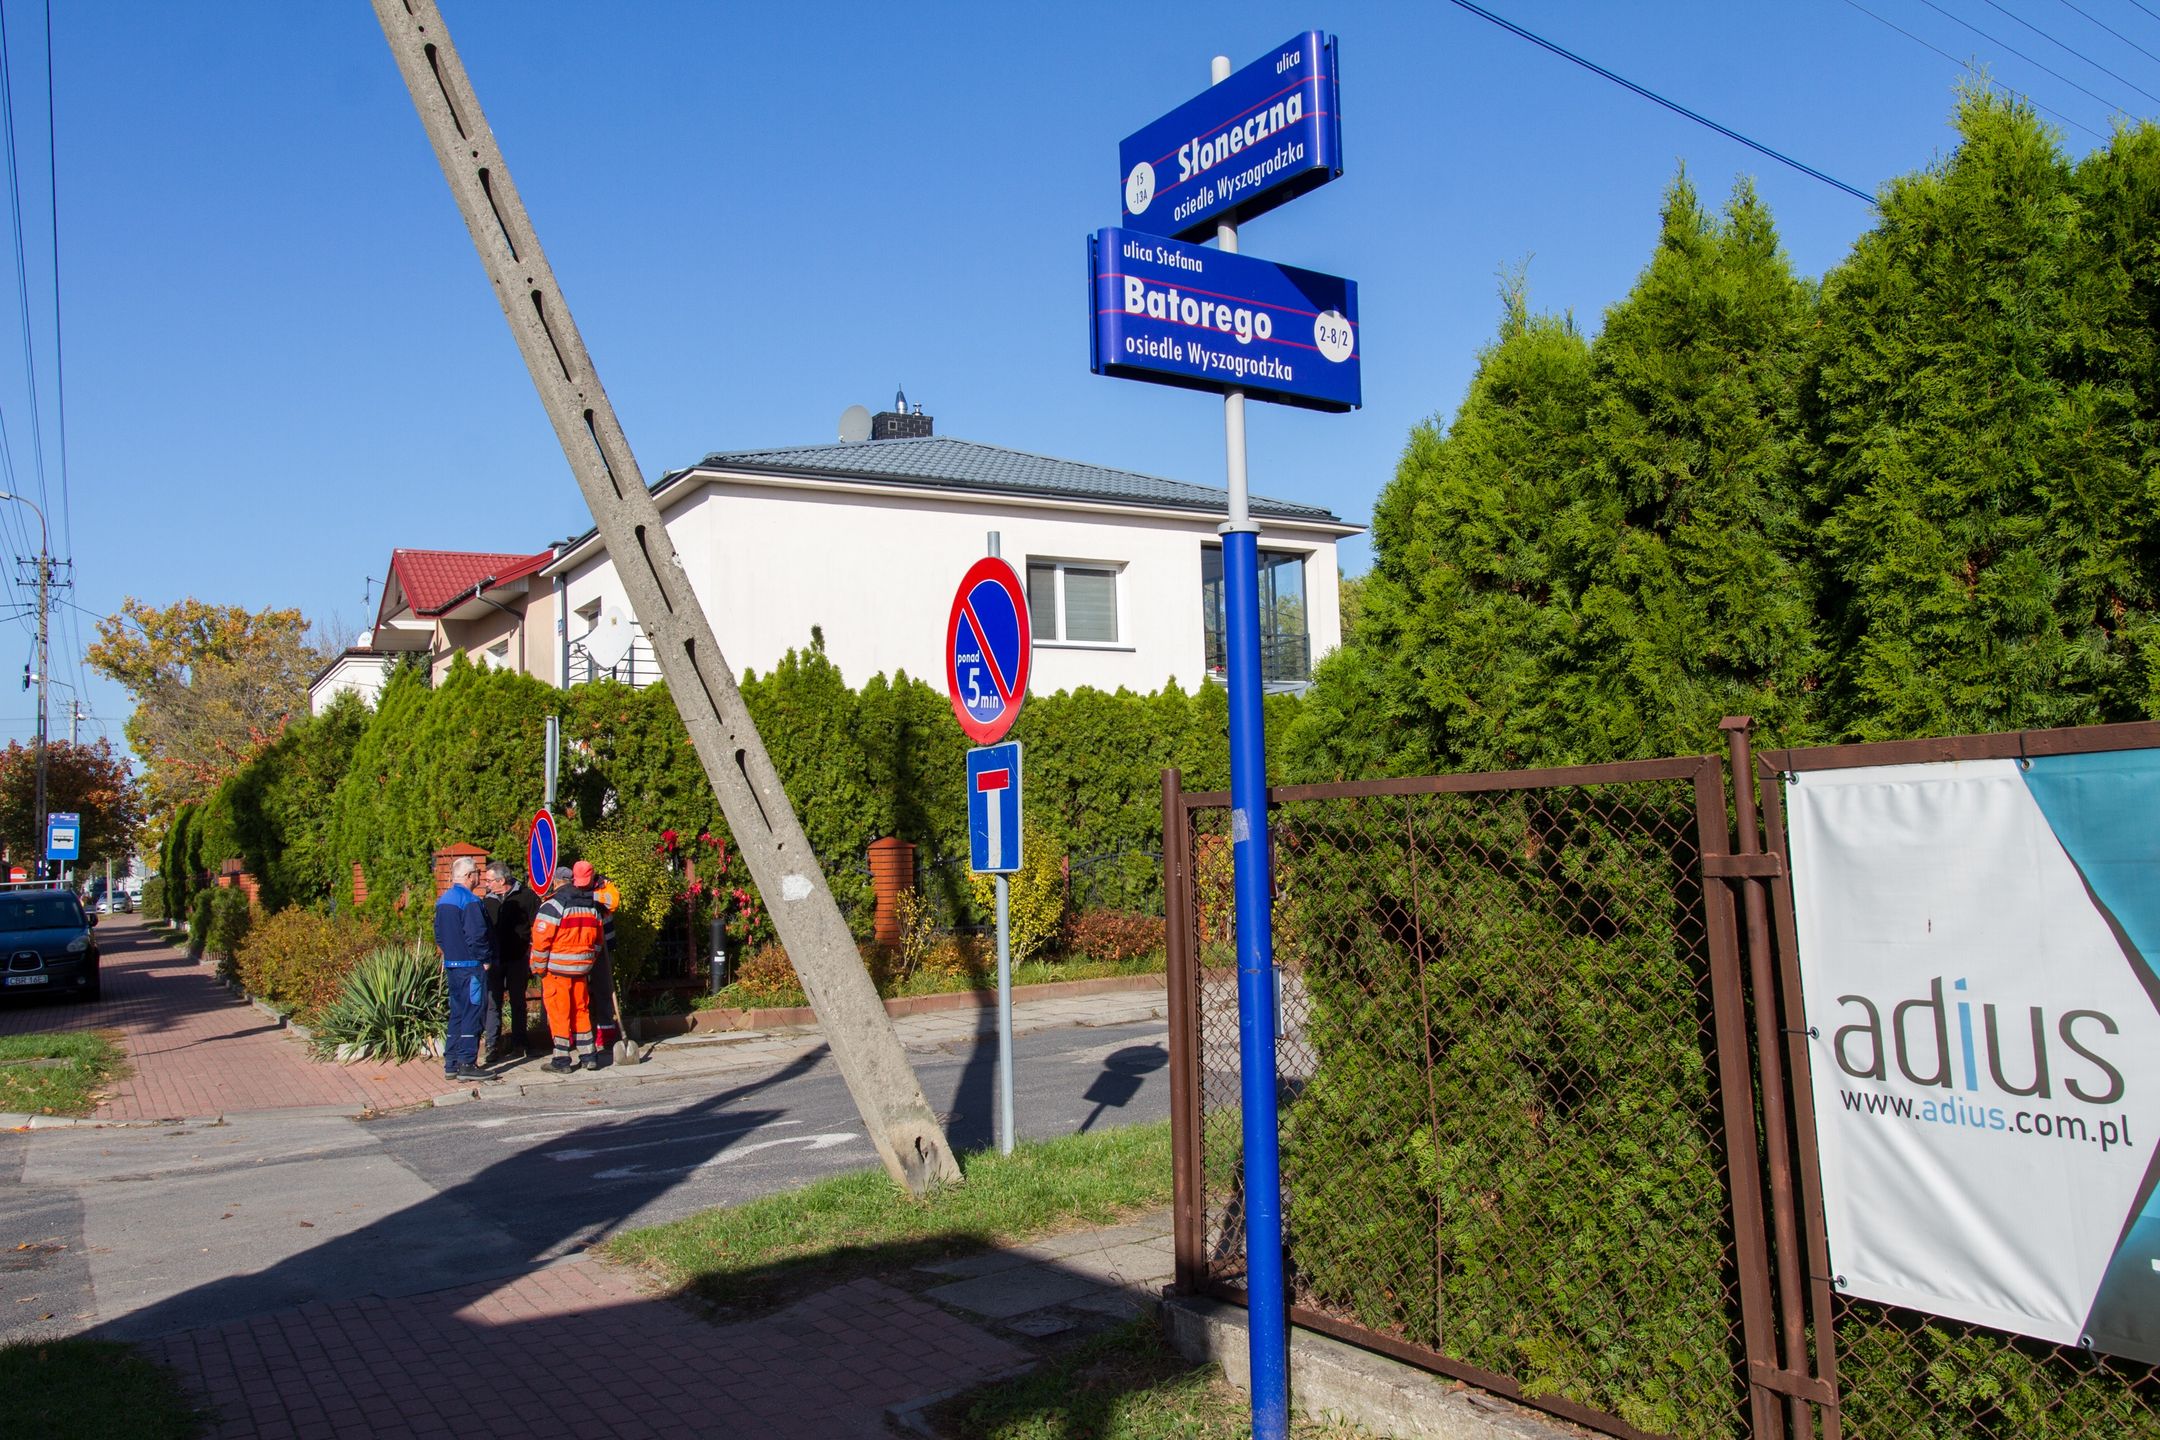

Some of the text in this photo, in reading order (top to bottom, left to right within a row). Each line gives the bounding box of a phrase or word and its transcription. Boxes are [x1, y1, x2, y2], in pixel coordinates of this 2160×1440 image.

[1276, 50, 1301, 75] ulica
[1177, 91, 1302, 183] Słoneczna
[1136, 172, 1144, 187] 15
[1173, 142, 1304, 222] osiedle Wyszogrodzka
[1123, 240, 1203, 273] ulica Stefana
[1124, 274, 1272, 344] Batorego
[1125, 334, 1293, 382] osiedle Wyszogrodzka
[1319, 325, 1348, 349] 2-8/2
[957, 650, 980, 667] ponad
[967, 667, 999, 709] 5 min
[1833, 975, 2125, 1105] adius
[1840, 1088, 2133, 1151] www.adius.com.pl
